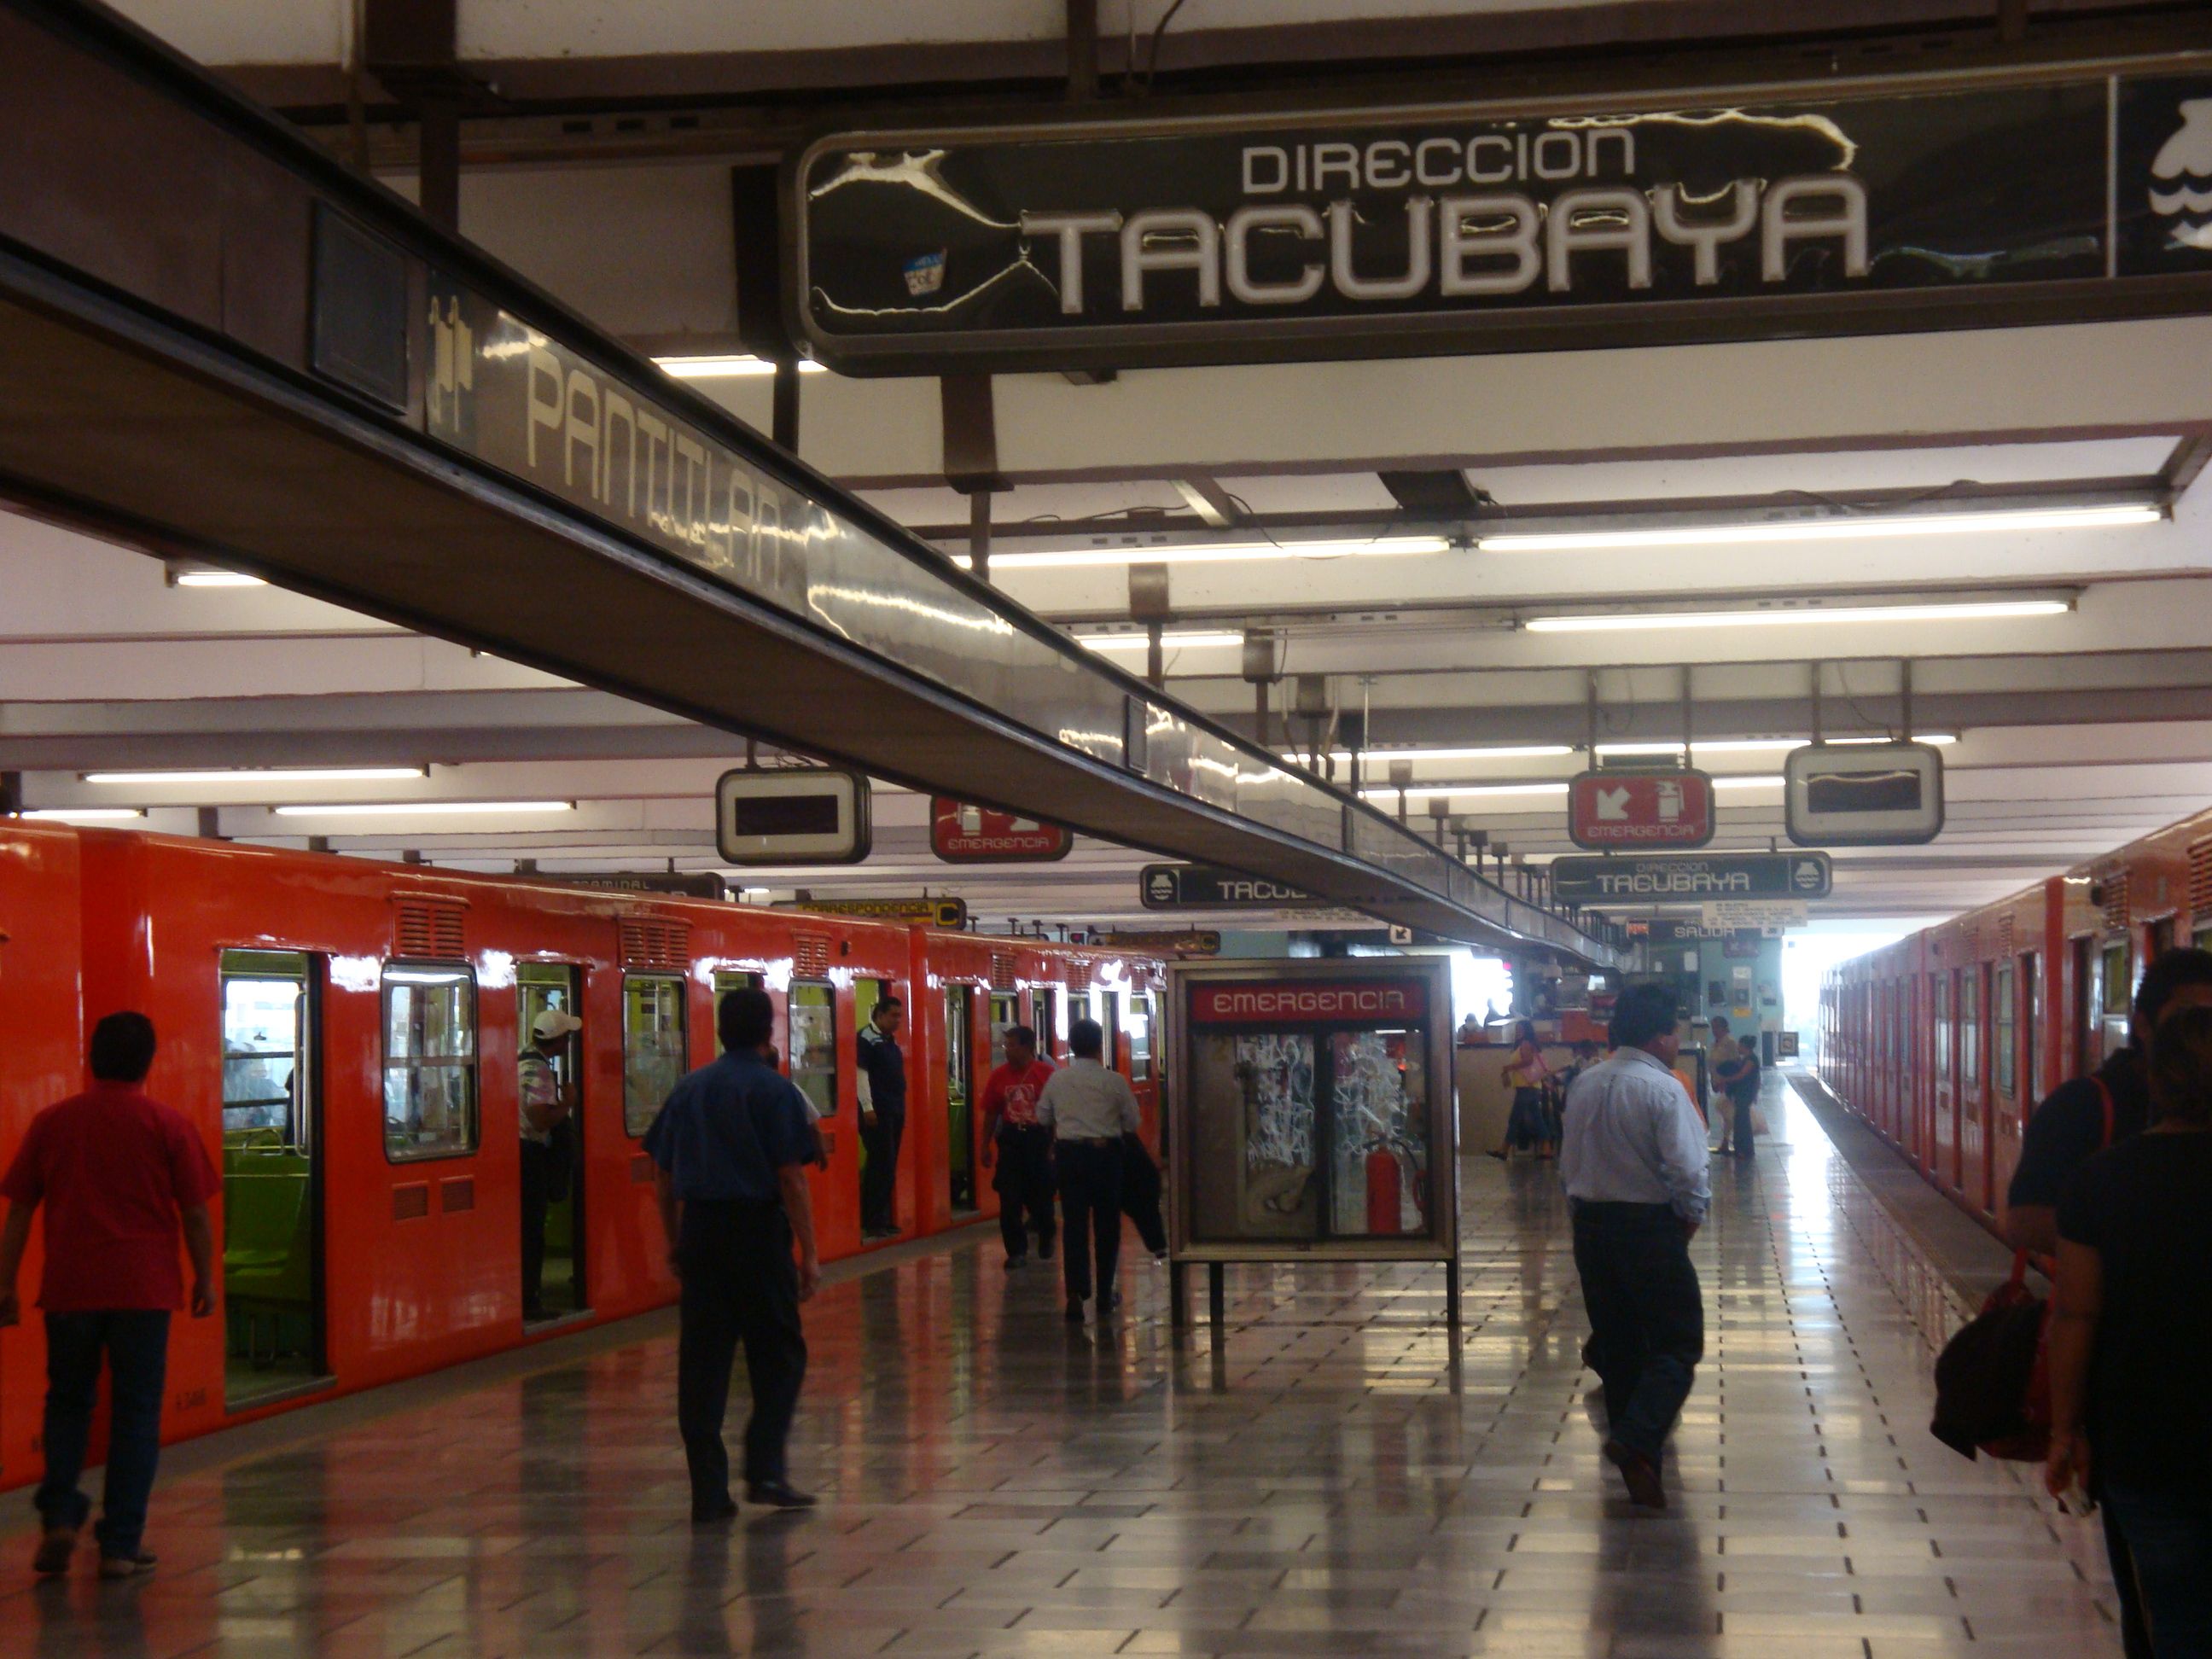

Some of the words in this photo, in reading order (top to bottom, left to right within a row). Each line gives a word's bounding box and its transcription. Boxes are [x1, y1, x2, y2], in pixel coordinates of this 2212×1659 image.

[1242, 127, 1635, 195] DIRECCION
[1020, 177, 1869, 314] TACUBAYA
[527, 338, 781, 591] PANTITLAN
[1587, 824, 1695, 838] EMERGENCIA
[948, 836, 1050, 850] EMERGENCIA
[1596, 872, 1749, 894] TACUBAYA
[1213, 990, 1406, 1013] EMERGENCIA
